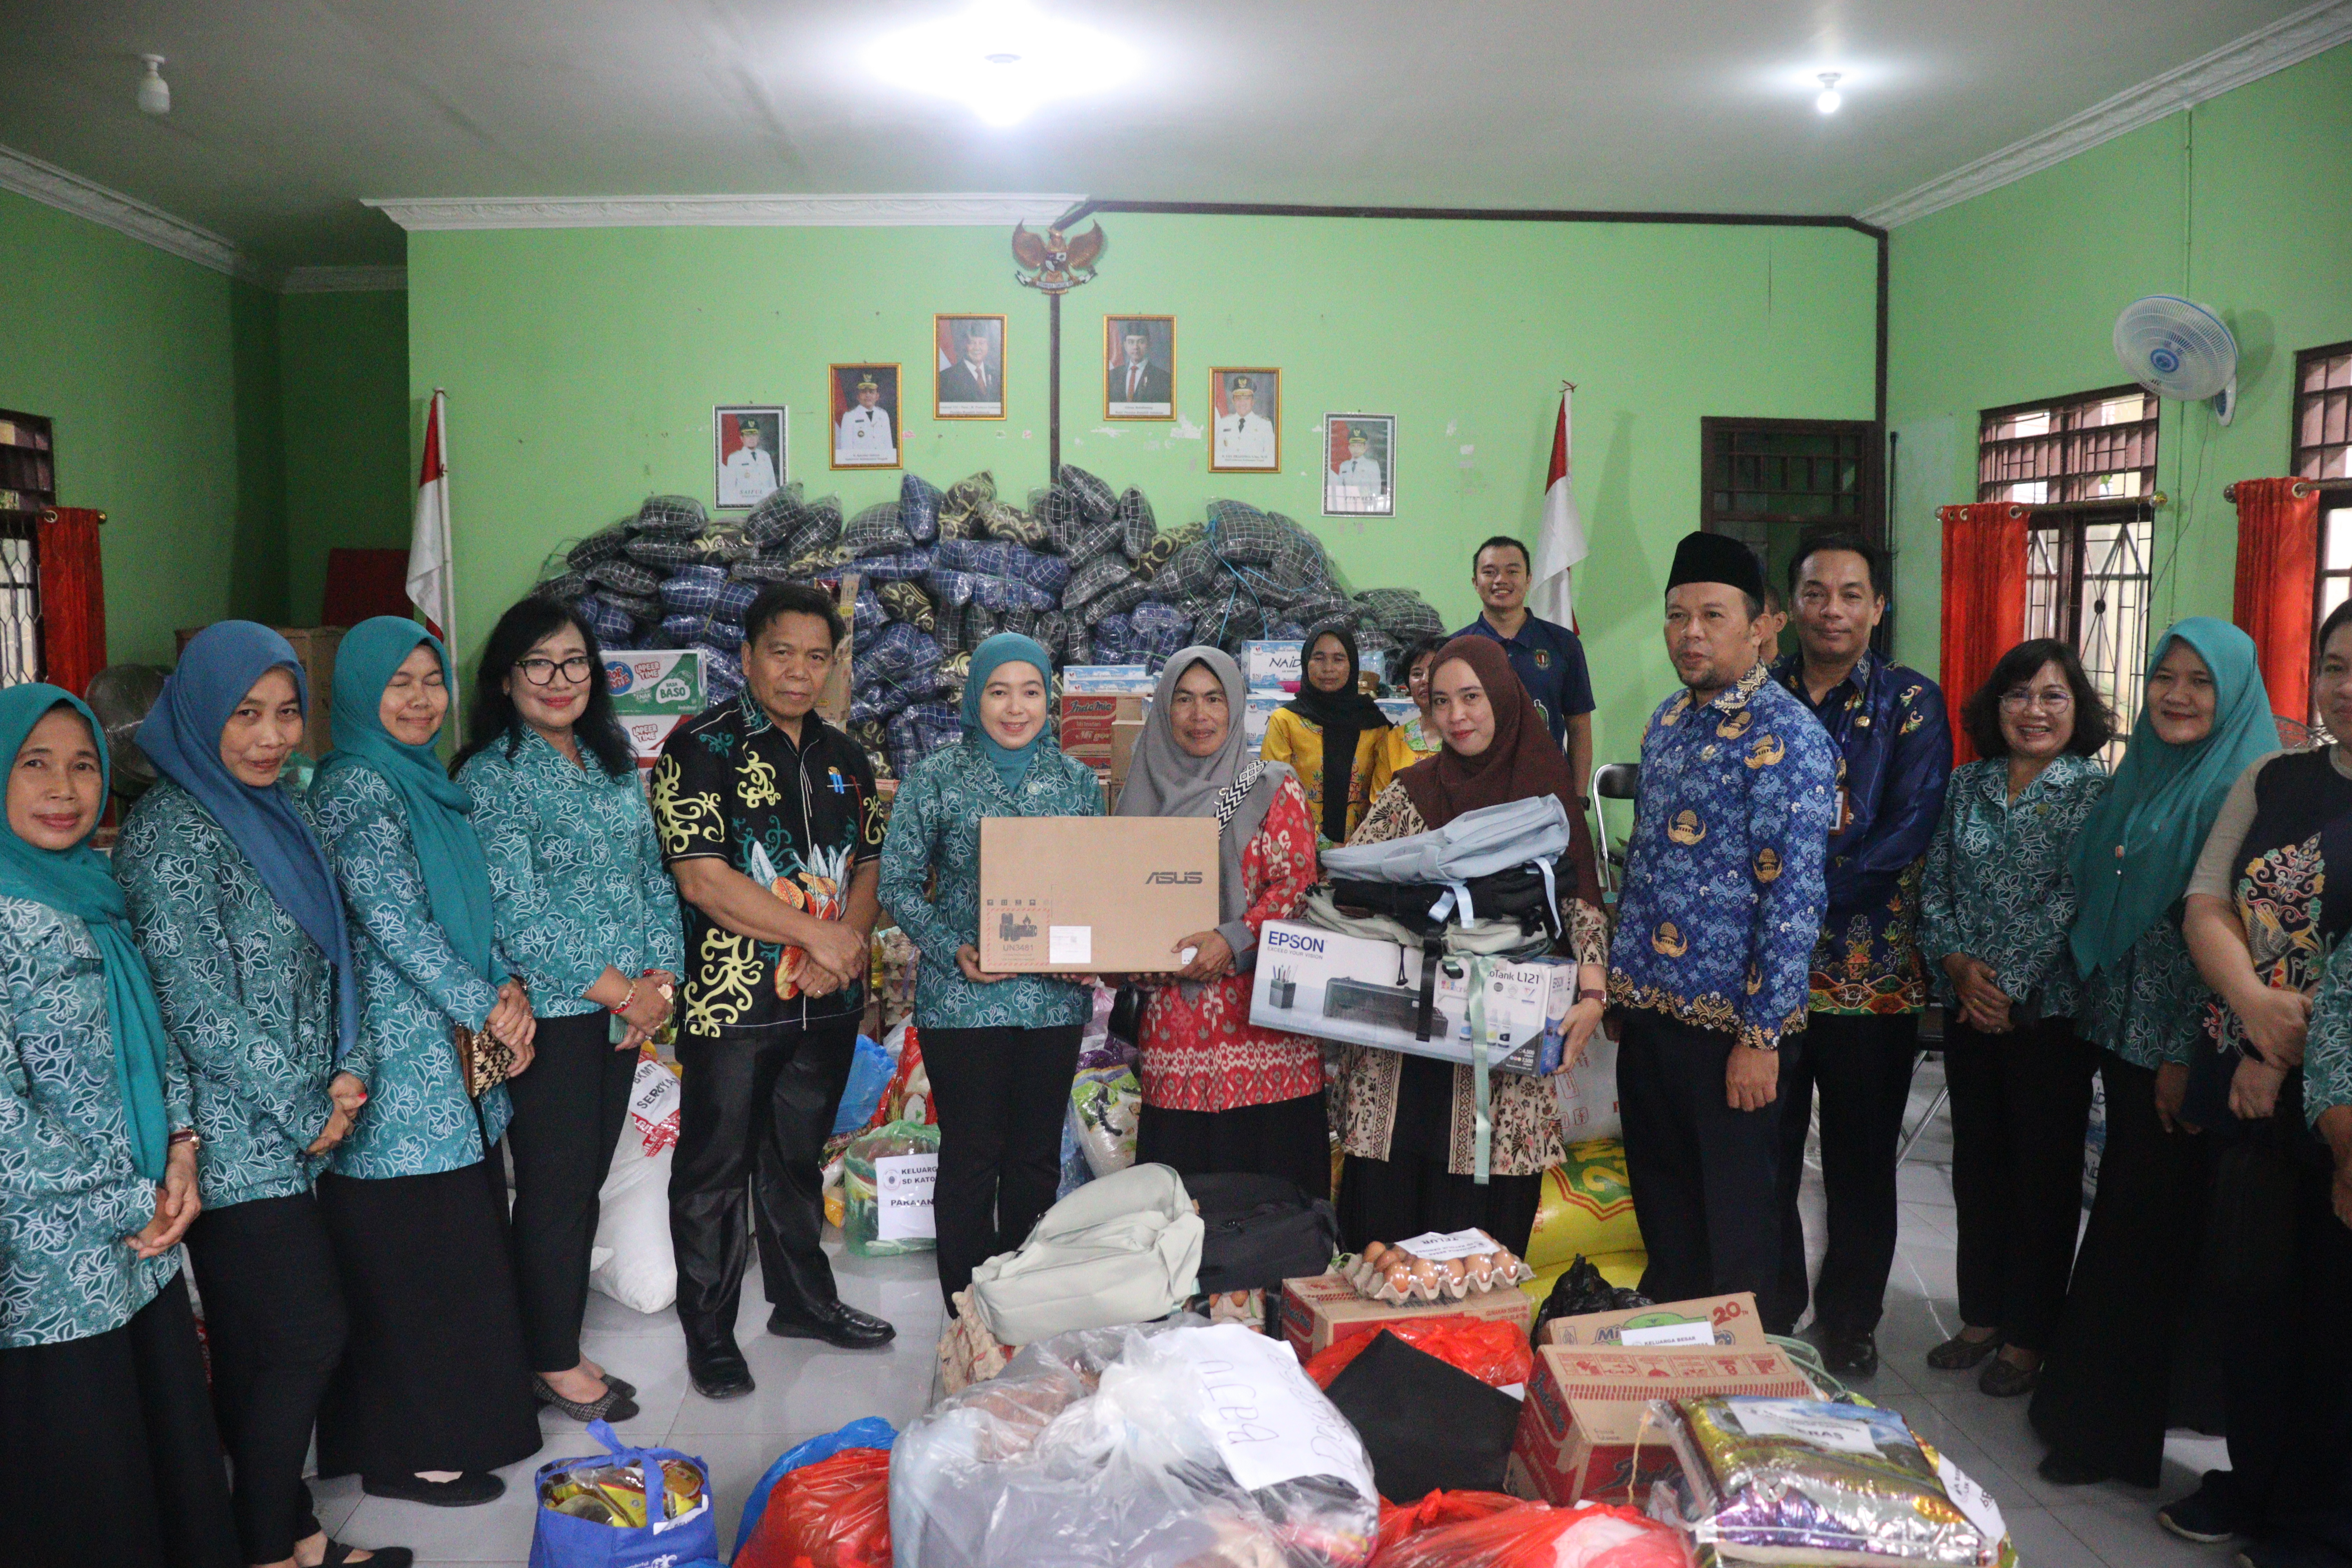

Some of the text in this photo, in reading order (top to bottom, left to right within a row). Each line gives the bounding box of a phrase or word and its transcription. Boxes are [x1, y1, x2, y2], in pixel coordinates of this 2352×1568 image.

[635, 661, 660, 673] LAPEER
[1269, 656, 1302, 668] NAID
[639, 670, 659, 680] TIME
[660, 687, 685, 699] BASO
[632, 724, 657, 736] LAPEER
[637, 732, 657, 742] TIME
[1145, 872, 1203, 885] ASUS
[1269, 931, 1325, 953] EPSON
[1517, 971, 1539, 984] L121
[902, 1166, 937, 1174] KELUARG
[1713, 1301, 1741, 1326] 20
